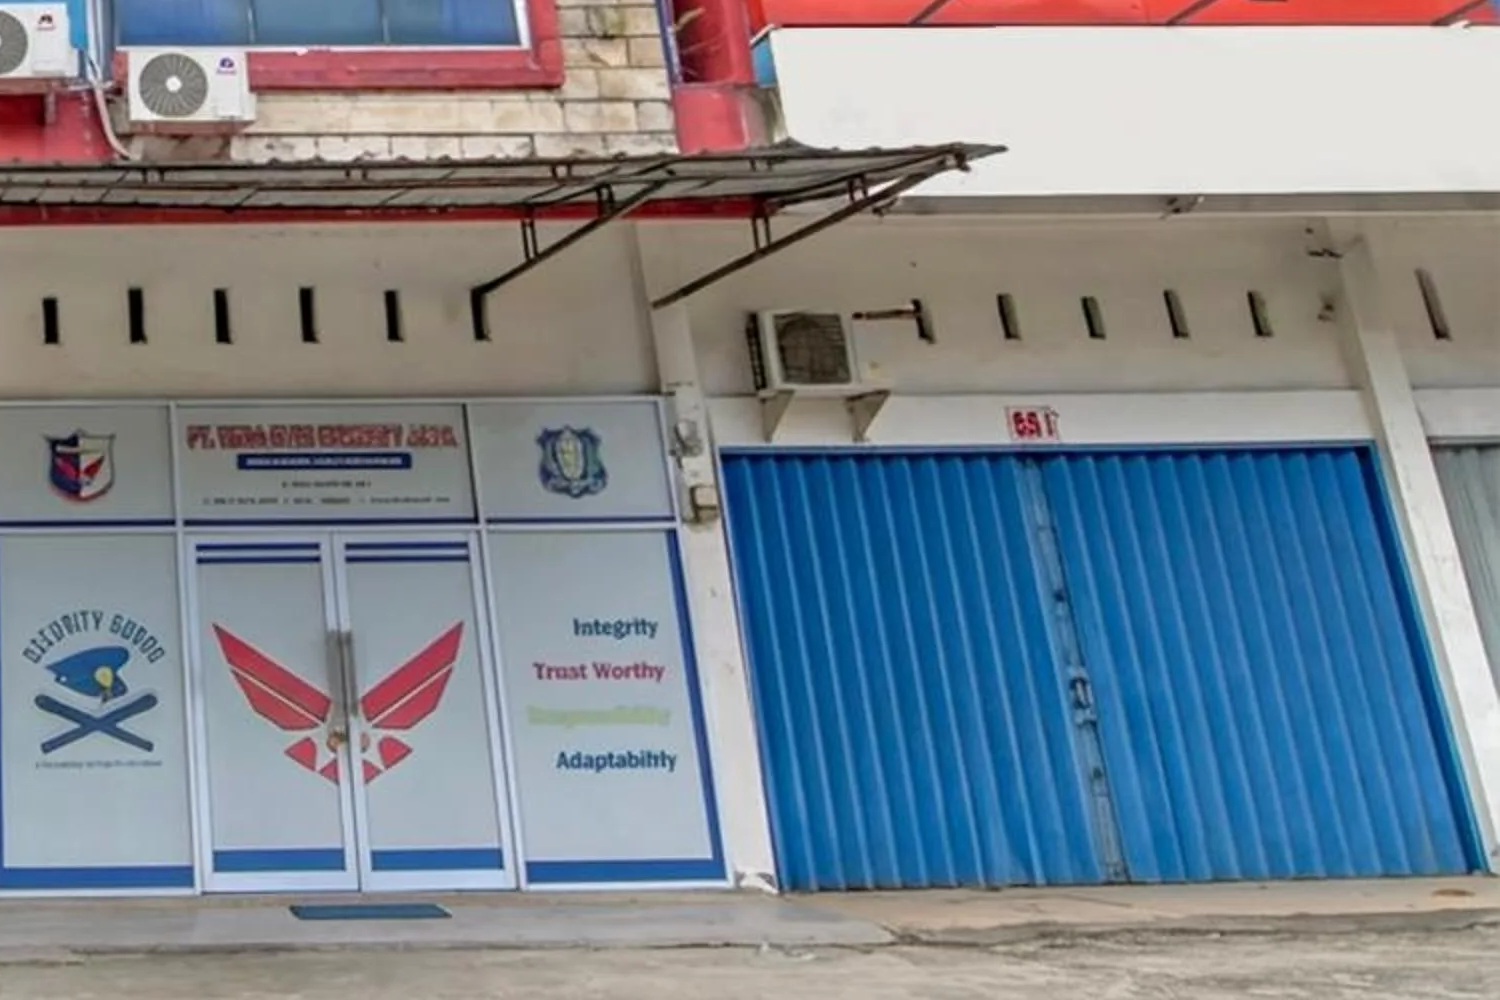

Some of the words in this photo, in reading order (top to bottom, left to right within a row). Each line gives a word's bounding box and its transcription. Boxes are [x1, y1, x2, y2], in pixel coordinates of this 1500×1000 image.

[573, 618, 658, 640] Integrity
[532, 662, 587, 681] Trust
[592, 660, 665, 683] Worthy
[556, 751, 677, 773] Adaptability
